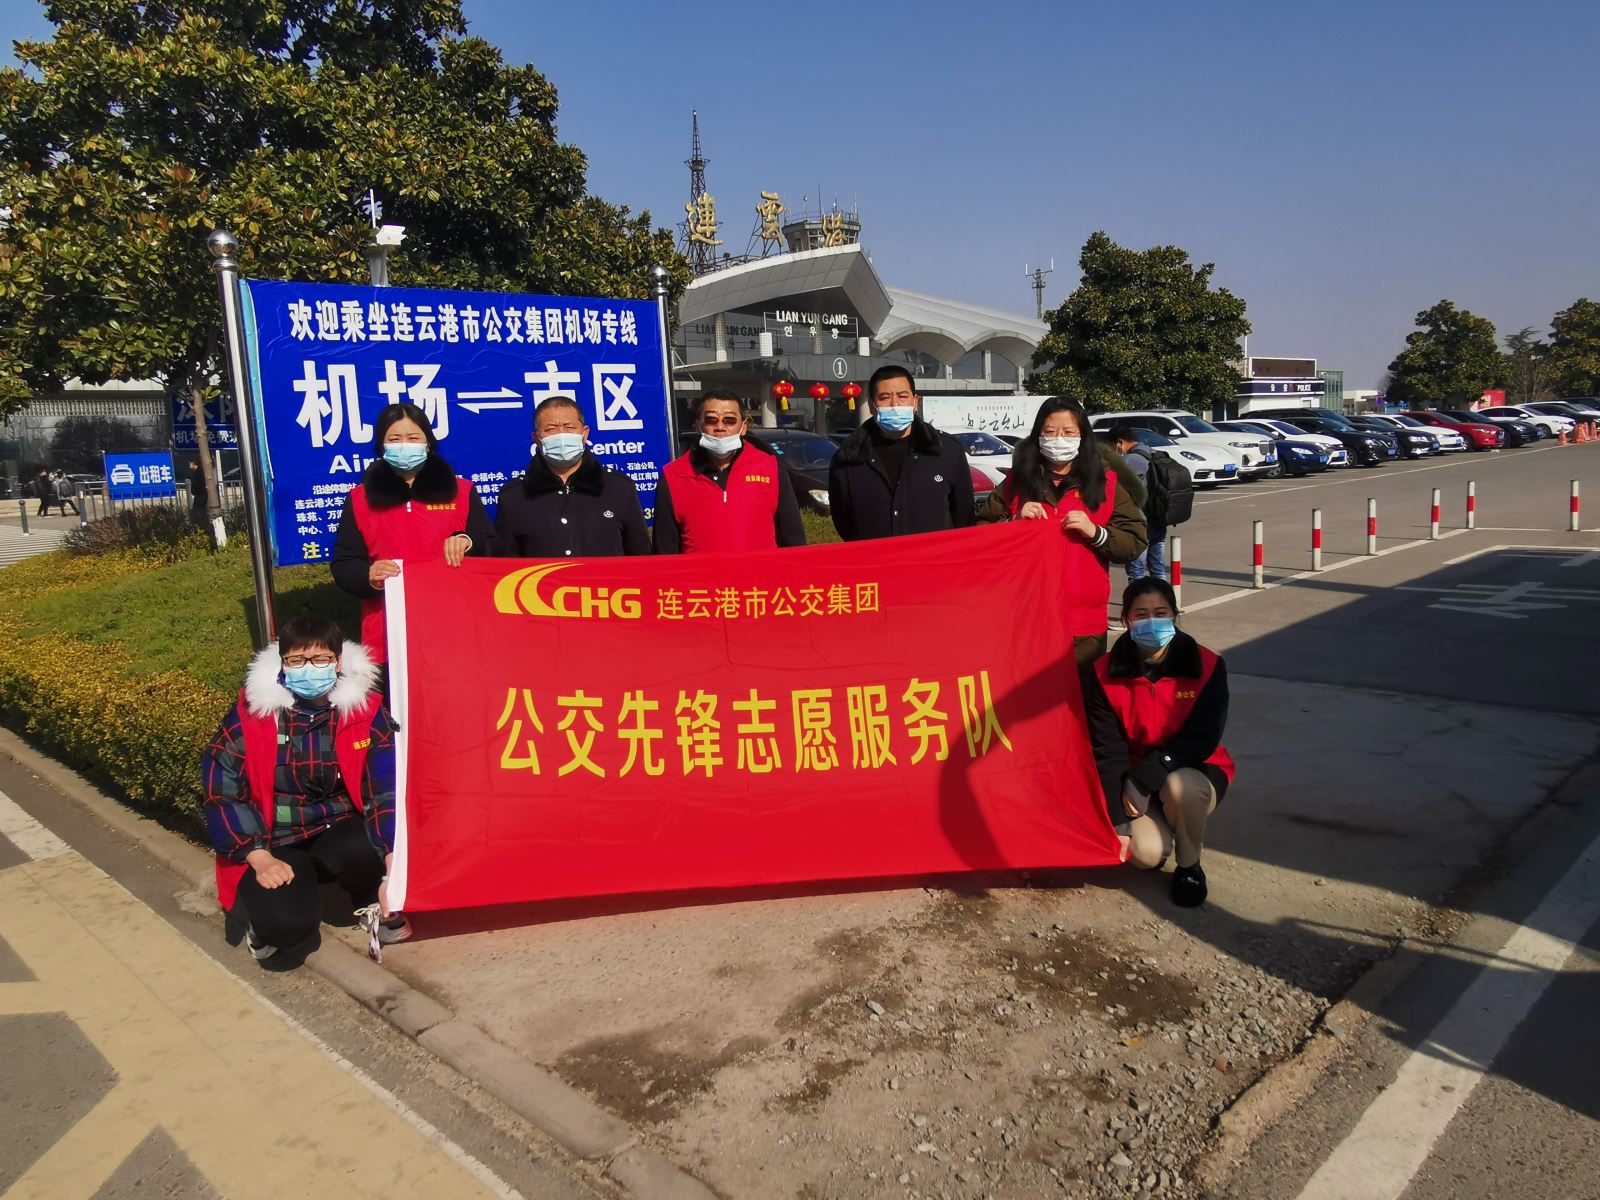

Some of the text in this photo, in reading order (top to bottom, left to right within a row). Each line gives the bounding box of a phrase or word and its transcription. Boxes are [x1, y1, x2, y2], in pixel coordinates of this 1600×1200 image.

[288, 299, 639, 346] 欢迎乘坐连云港市公交集团机场专线
[776, 310, 848, 325] LIAN YUN GANG
[1297, 384, 1311, 392] POLICE
[293, 360, 449, 447] 机场
[139, 464, 172, 484] 出租车
[295, 497, 346, 510] 连云港火车
[657, 582, 879, 619] 连云港市公交集团
[496, 670, 1012, 778] 公交先锋志愿服务队
